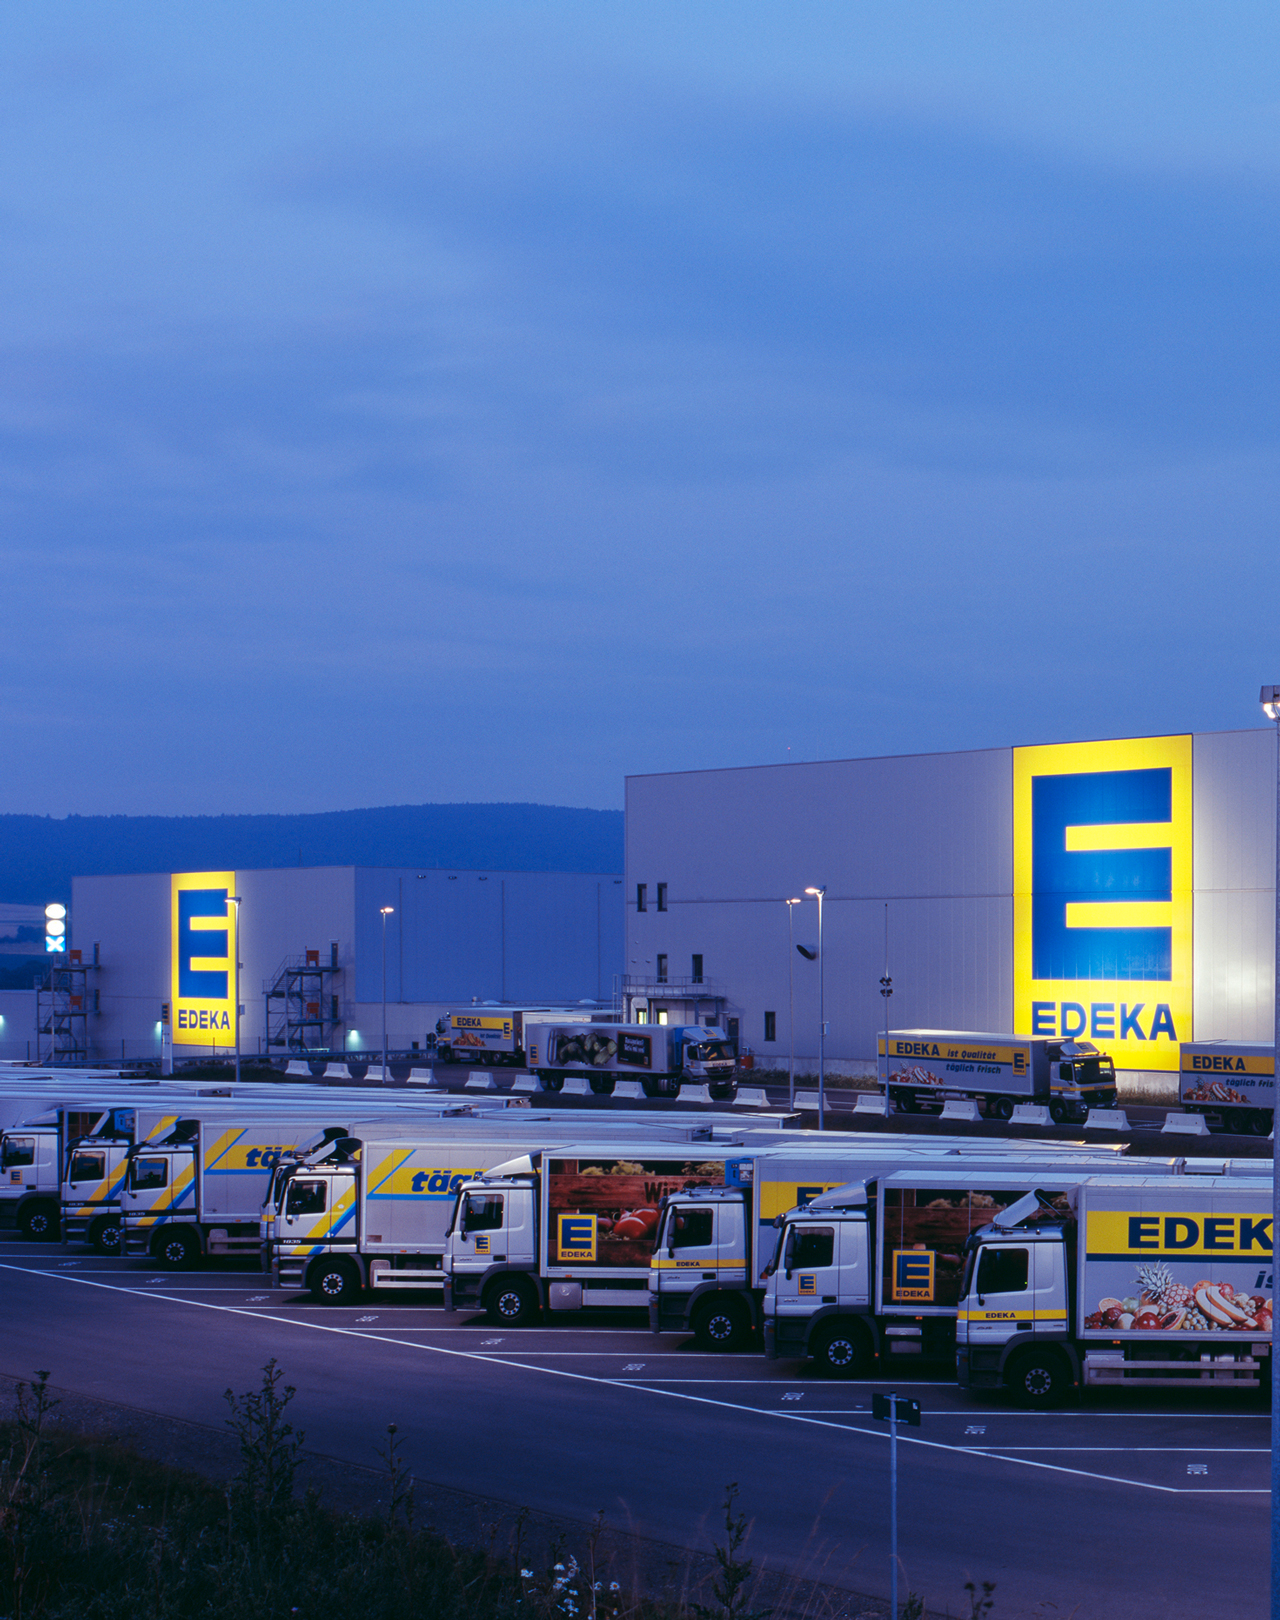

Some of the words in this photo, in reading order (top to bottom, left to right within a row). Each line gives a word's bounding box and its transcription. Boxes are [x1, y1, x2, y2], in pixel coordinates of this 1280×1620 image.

[1031, 767, 1172, 981] E
[178, 888, 228, 999] E
[178, 1009, 231, 1030] EDEKA
[456, 1017, 482, 1027] EDEKA
[1031, 1001, 1178, 1041] EDEKA
[896, 1042, 940, 1056] EDEKA
[947, 1049, 959, 1058] ist
[961, 1050, 996, 1060] Qualität
[946, 1063, 975, 1073] täglich
[977, 1065, 1002, 1074] frisch
[1014, 1053, 1024, 1069] E
[1192, 1056, 1246, 1071] EDEKA
[1226, 1078, 1256, 1088] täglich
[1258, 1079, 1275, 1088] fris
[561, 1218, 592, 1249] E
[476, 1236, 489, 1249] E
[896, 1255, 930, 1288] E
[800, 1276, 814, 1289] E
[896, 1290, 930, 1298] EDEKA
